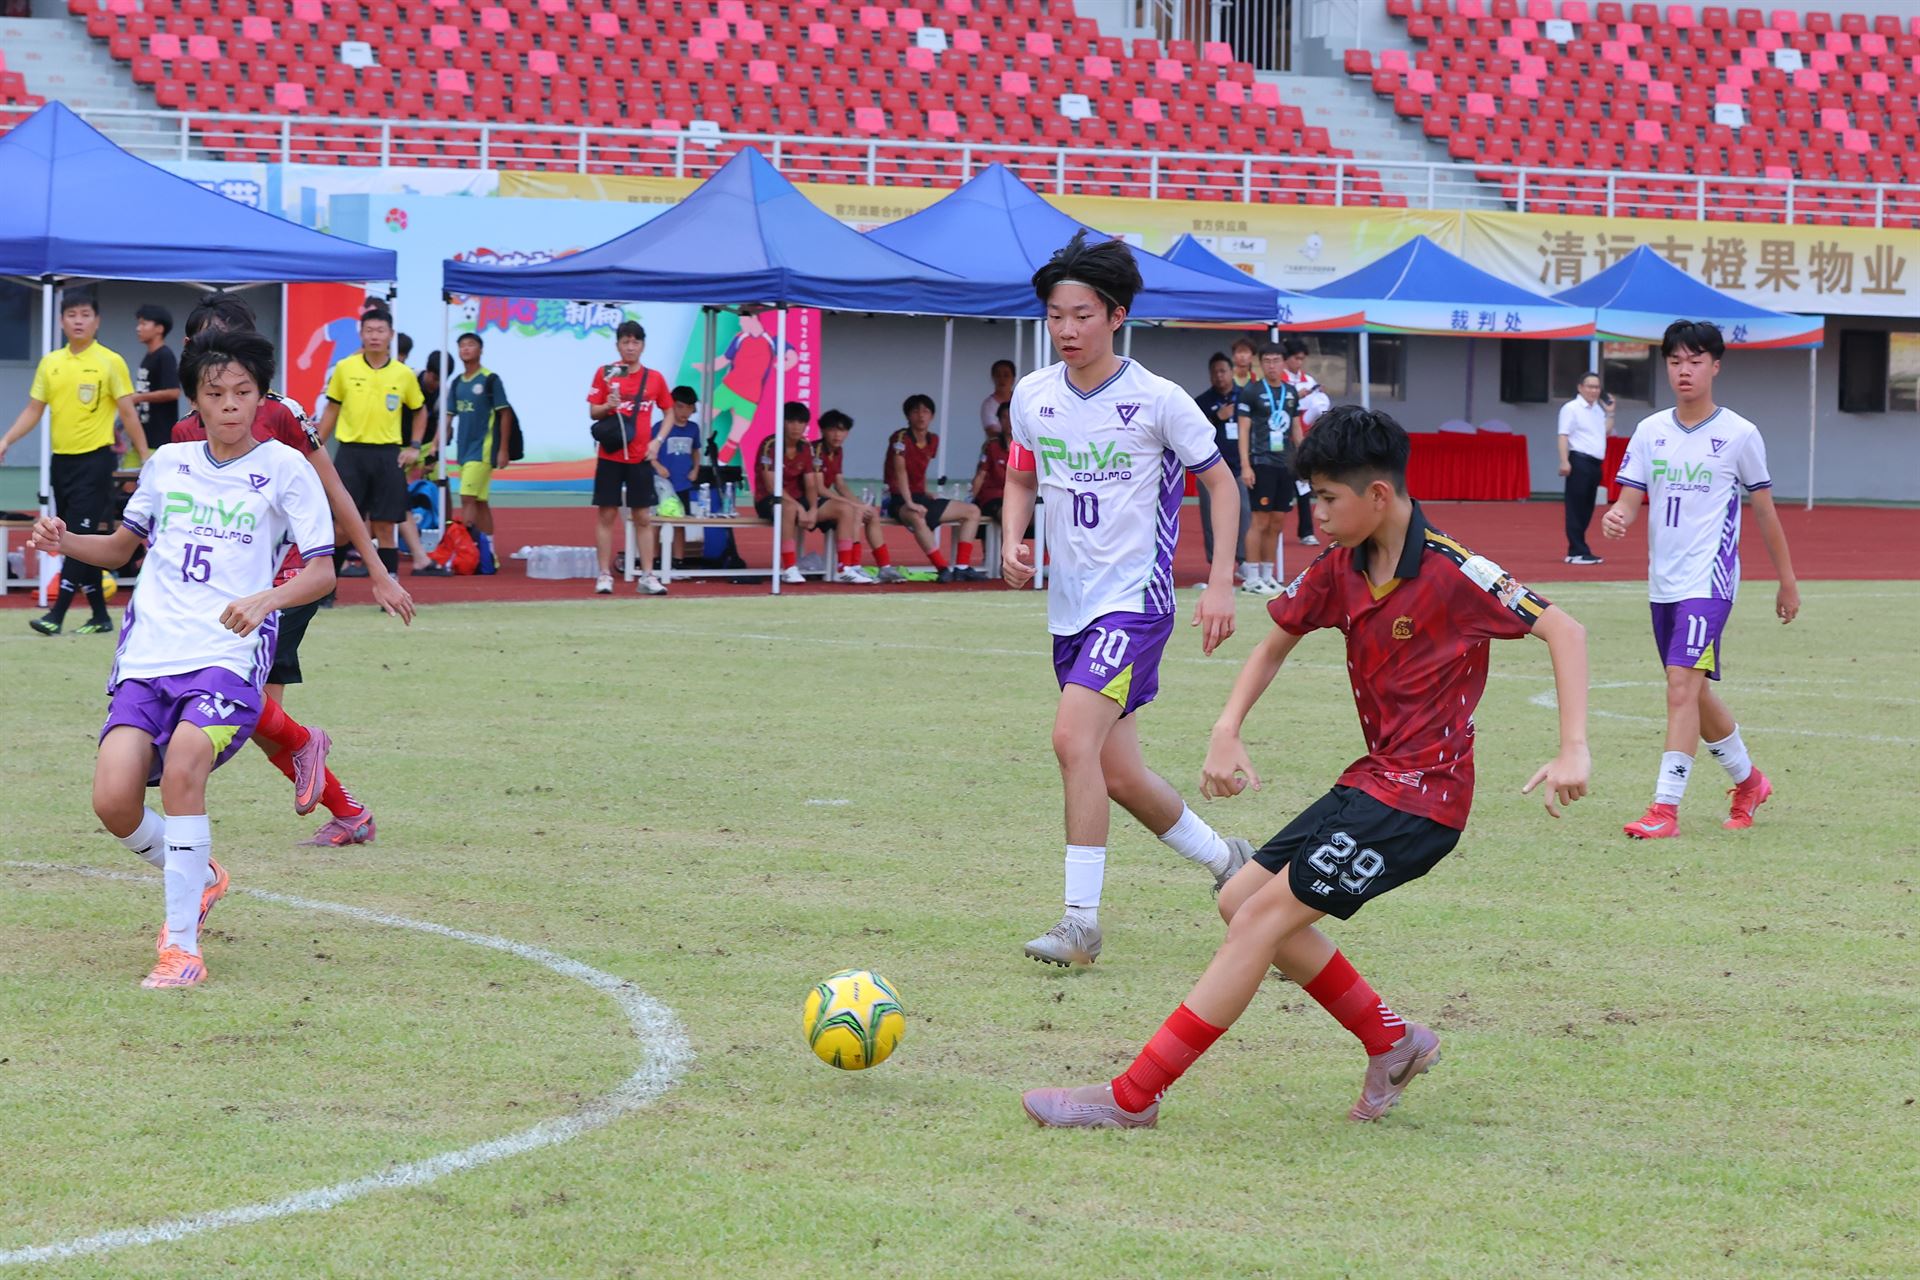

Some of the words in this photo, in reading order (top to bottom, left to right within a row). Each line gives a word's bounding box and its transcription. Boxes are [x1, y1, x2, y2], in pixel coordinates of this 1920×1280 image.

[835, 204, 922, 217] 官方战略合作伙
[1192, 219, 1248, 232] 官方供应商
[1538, 230, 1907, 295] 清远市橙果物业
[1451, 310, 1522, 332] 裁判处
[1067, 488, 1099, 529] 10
[1666, 496, 1682, 528] 11
[181, 543, 214, 584] 15
[1088, 626, 1131, 669] 10
[1686, 614, 1708, 648] 11
[1307, 831, 1387, 895] 29
